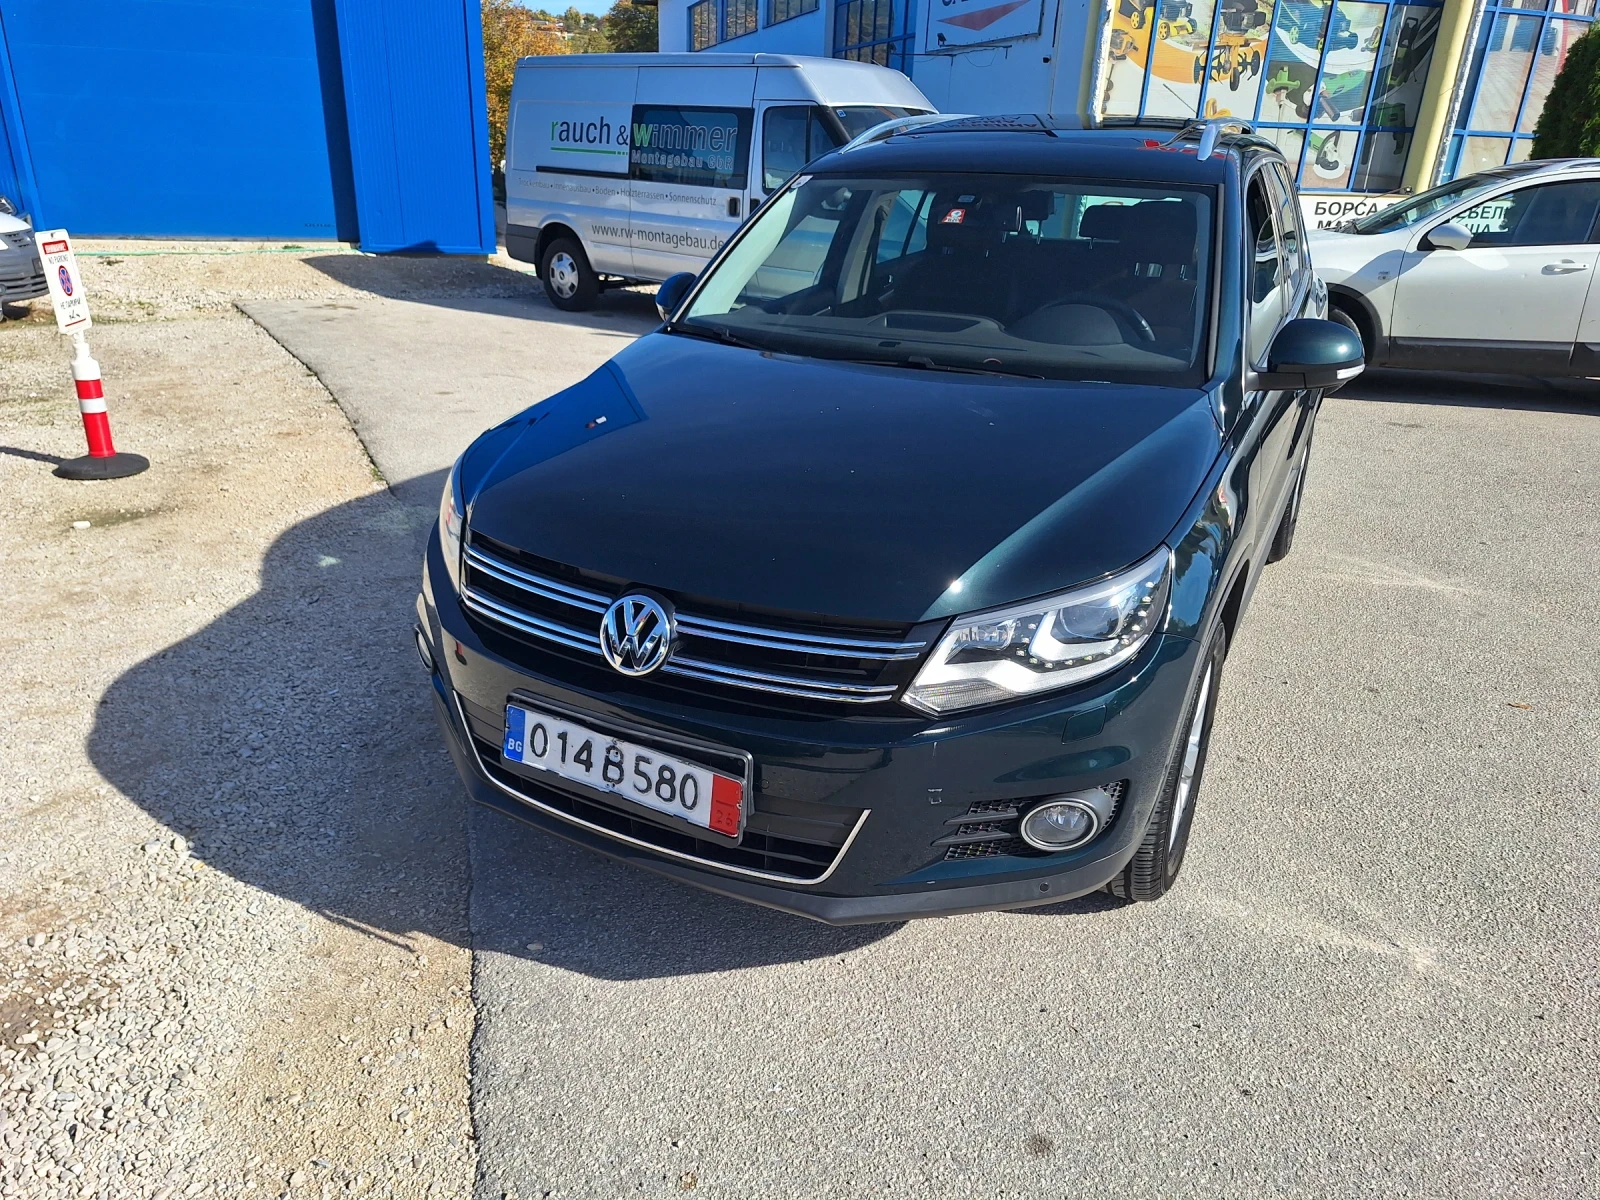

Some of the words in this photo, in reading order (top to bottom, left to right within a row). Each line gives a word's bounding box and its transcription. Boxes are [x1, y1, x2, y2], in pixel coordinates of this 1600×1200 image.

[551, 116, 610, 145] rauch
[616, 124, 629, 146] &
[633, 123, 738, 152] wimmer
[631, 150, 703, 169] Montagebau
[708, 154, 733, 171] GbR
[553, 181, 591, 194] Innenausbau
[595, 185, 616, 196] Boden
[620, 188, 665, 200] Holzterrassen
[669, 192, 717, 206] Sonnenschutz
[1314, 201, 1378, 216] БОРСА
[592, 223, 724, 251] www.rw-montagebau.de
[507, 737, 523, 752] BG
